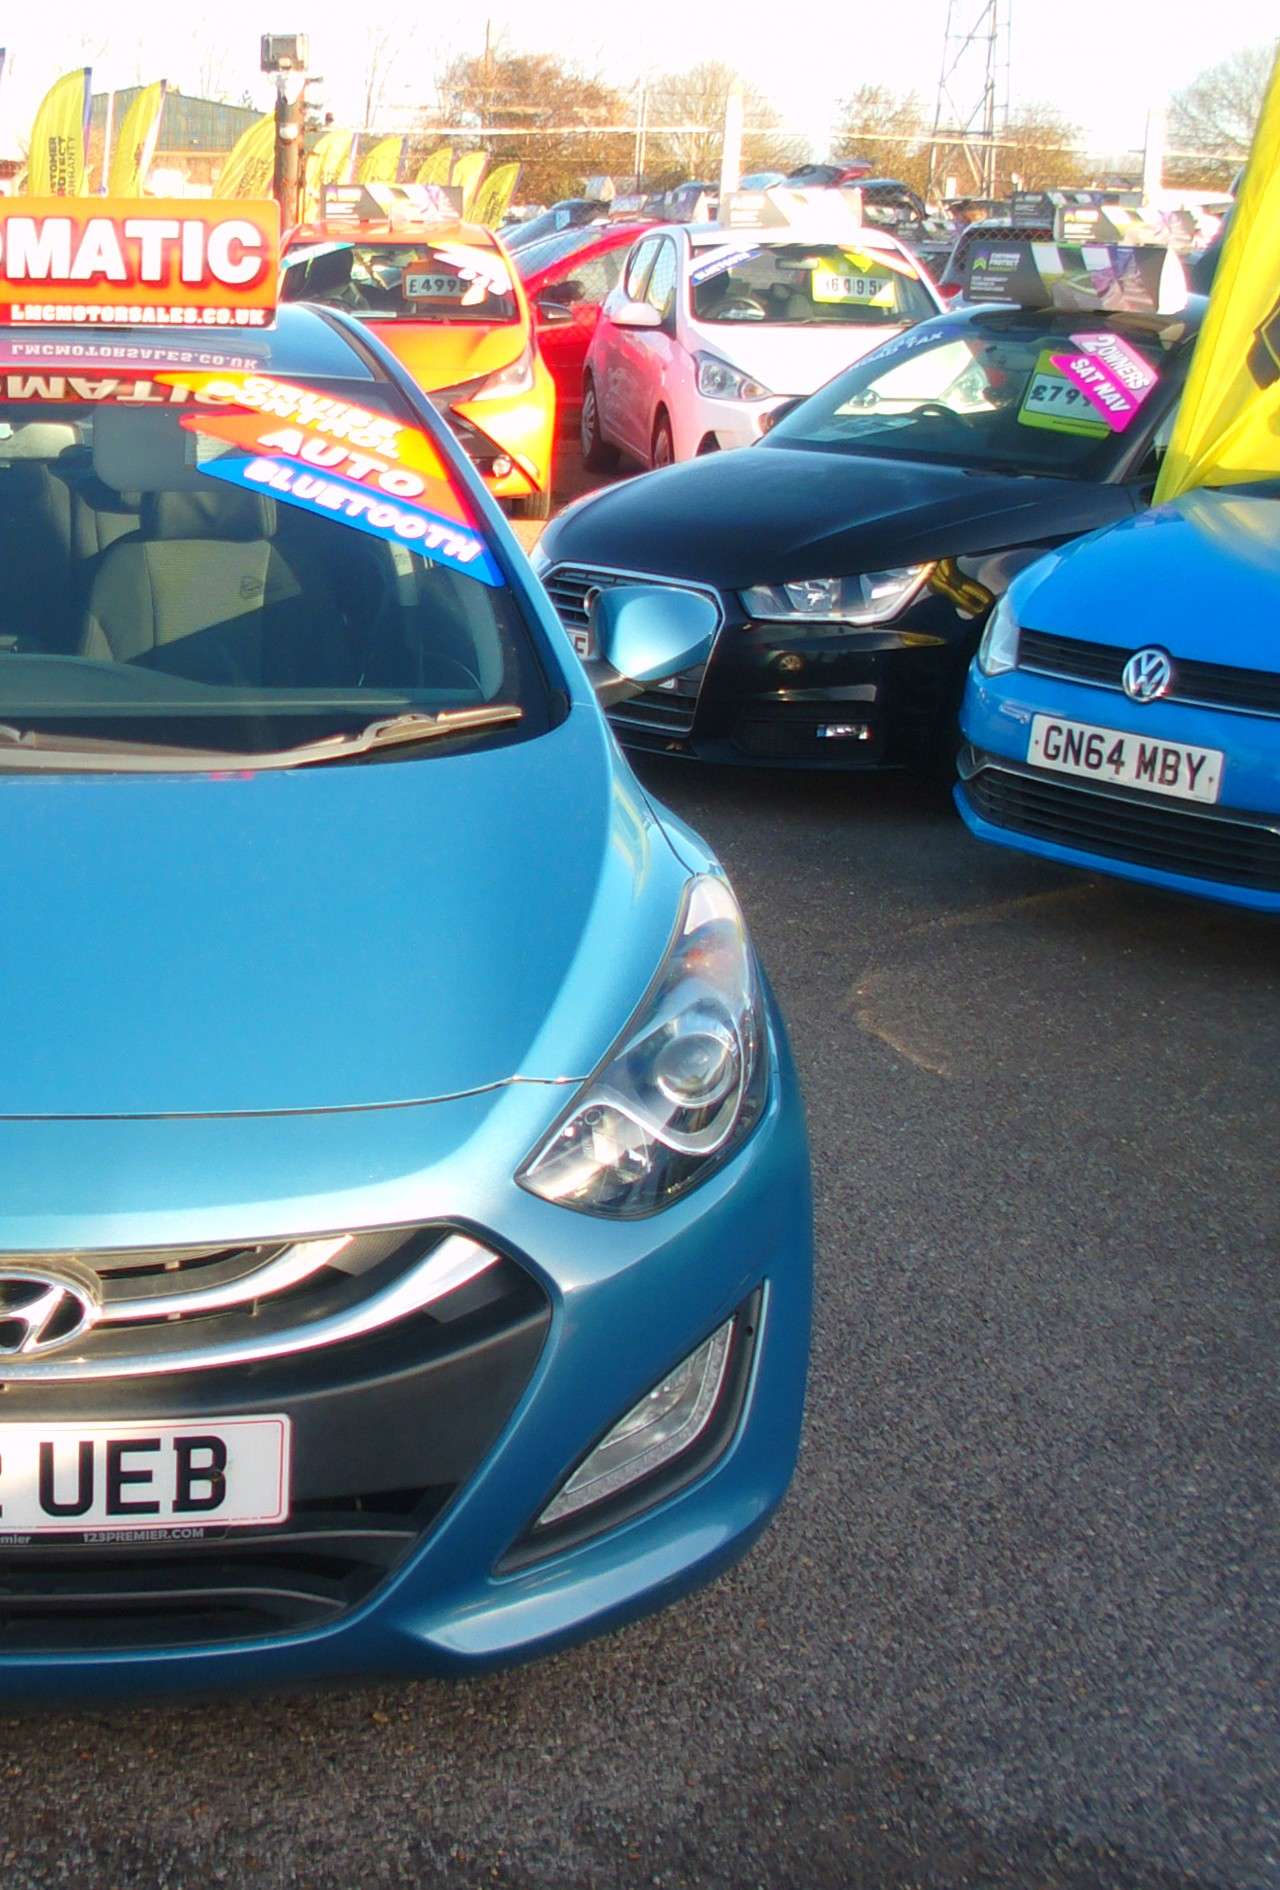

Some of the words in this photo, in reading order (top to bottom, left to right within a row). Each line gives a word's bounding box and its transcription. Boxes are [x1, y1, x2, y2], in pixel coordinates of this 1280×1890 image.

[11, 304, 265, 325] LMCMOTORSALES.CO.UK
[1030, 384, 1093, 407] £79
[1070, 358, 1105, 383] SAT
[1093, 382, 1131, 413] NAV
[1099, 345, 1151, 391] OWNERS
[257, 428, 425, 498] AUTO
[243, 458, 484, 563] BLUETOOTH
[1043, 724, 1126, 775] GN64
[1135, 743, 1207, 791] MBY
[39, 1435, 227, 1518] UEB
[83, 1527, 204, 1543] 123PREMIER.COM
